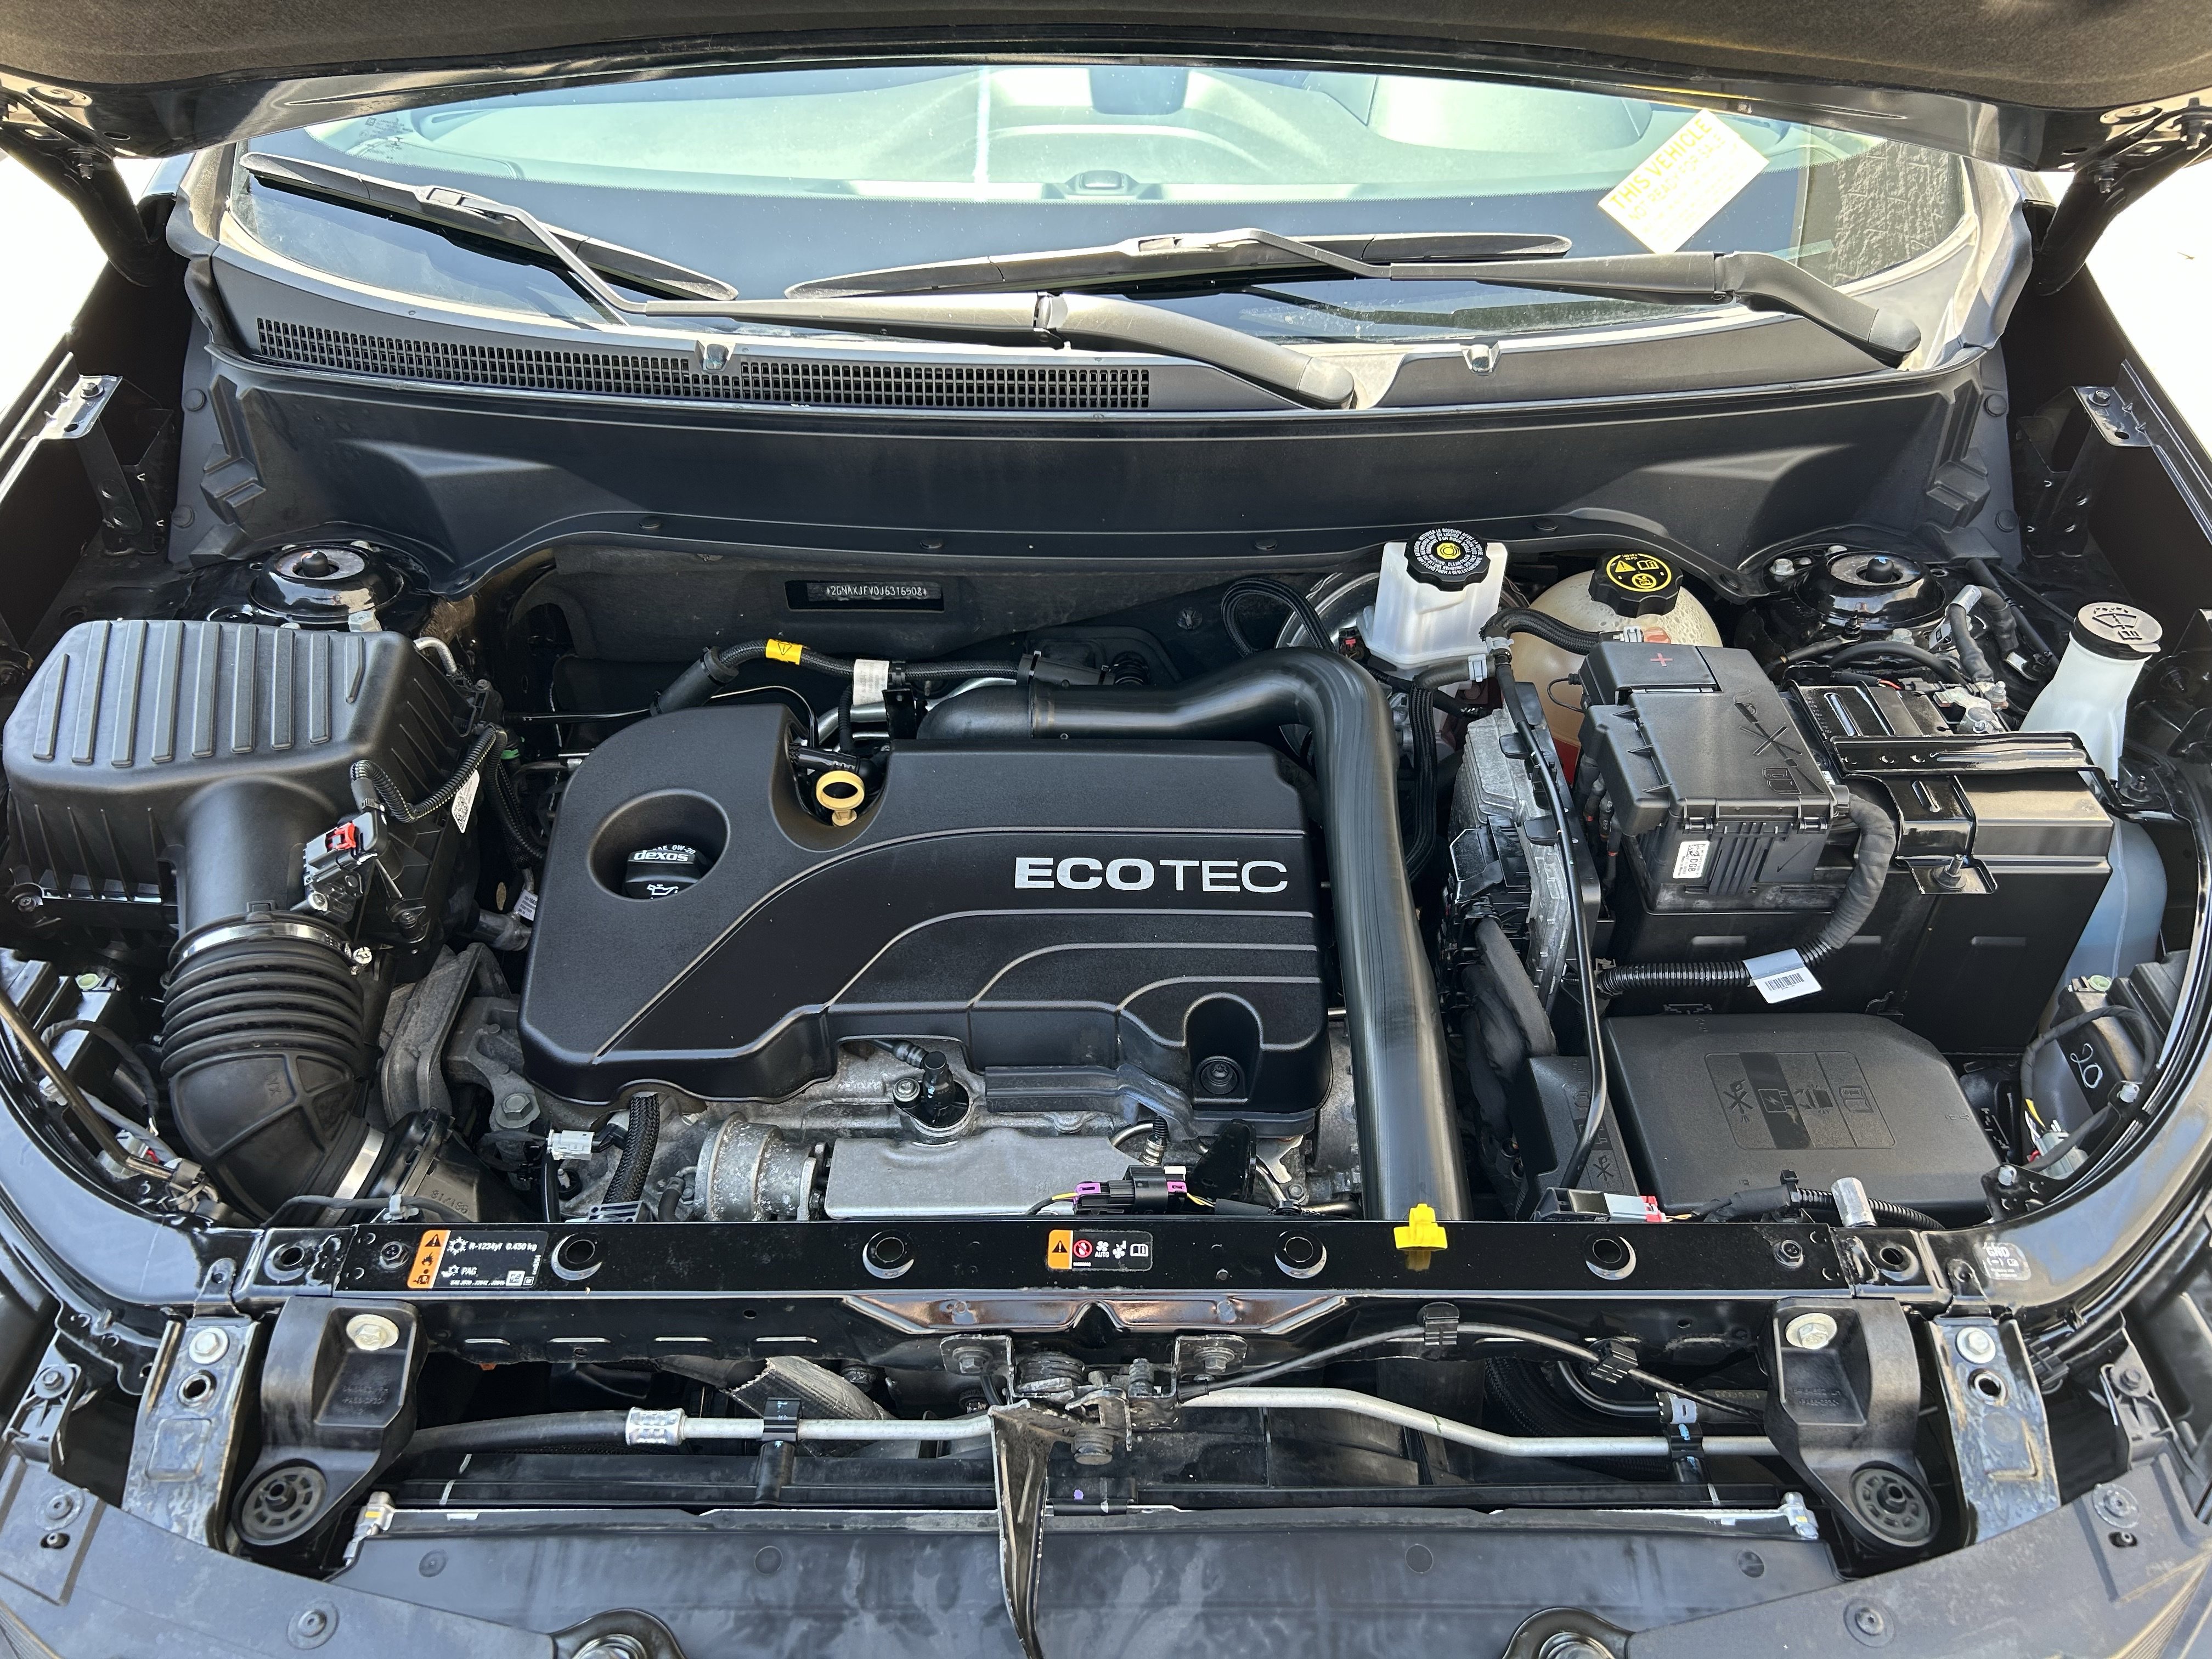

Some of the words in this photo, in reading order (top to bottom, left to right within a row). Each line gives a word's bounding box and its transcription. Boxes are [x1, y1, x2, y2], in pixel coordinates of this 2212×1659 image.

[1610, 174, 1651, 209] THIS
[1645, 118, 1712, 177] VEHICLE
[634, 850, 689, 862] dexos
[1014, 857, 1288, 893] ECOTEC
[468, 1242, 503, 1251] R-1234yf
[506, 1243, 527, 1251] 0.450
[527, 1243, 538, 1252] kg
[1985, 1246, 2010, 1258] GND
